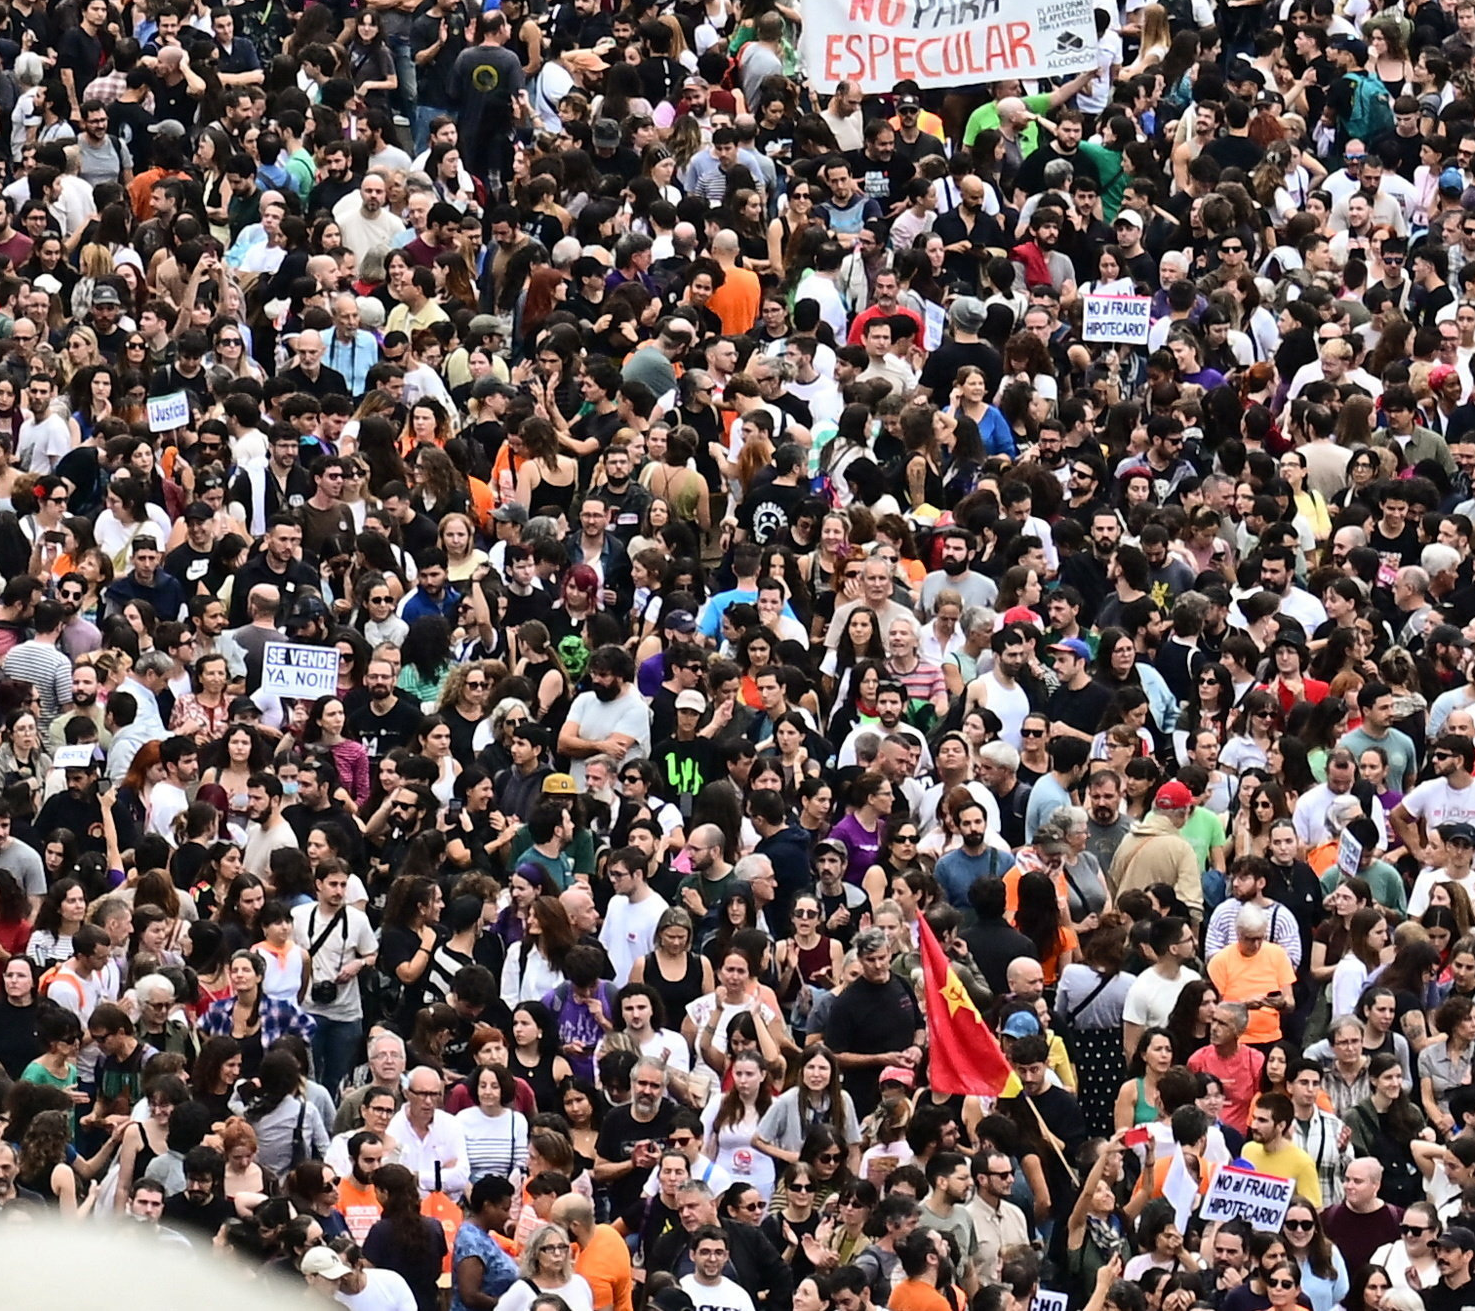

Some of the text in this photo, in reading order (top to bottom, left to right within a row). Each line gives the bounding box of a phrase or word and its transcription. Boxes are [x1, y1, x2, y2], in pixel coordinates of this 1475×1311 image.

[1038, 15, 1048, 25] DE
[824, 21, 1036, 81] ESPECULAR
[1088, 302, 1099, 315] NO
[1111, 302, 1147, 316] FRAUDE
[268, 647, 336, 669] SE VENDE
[1217, 1173, 1232, 1189] NO
[1245, 1179, 1290, 1202] FRAUDE
